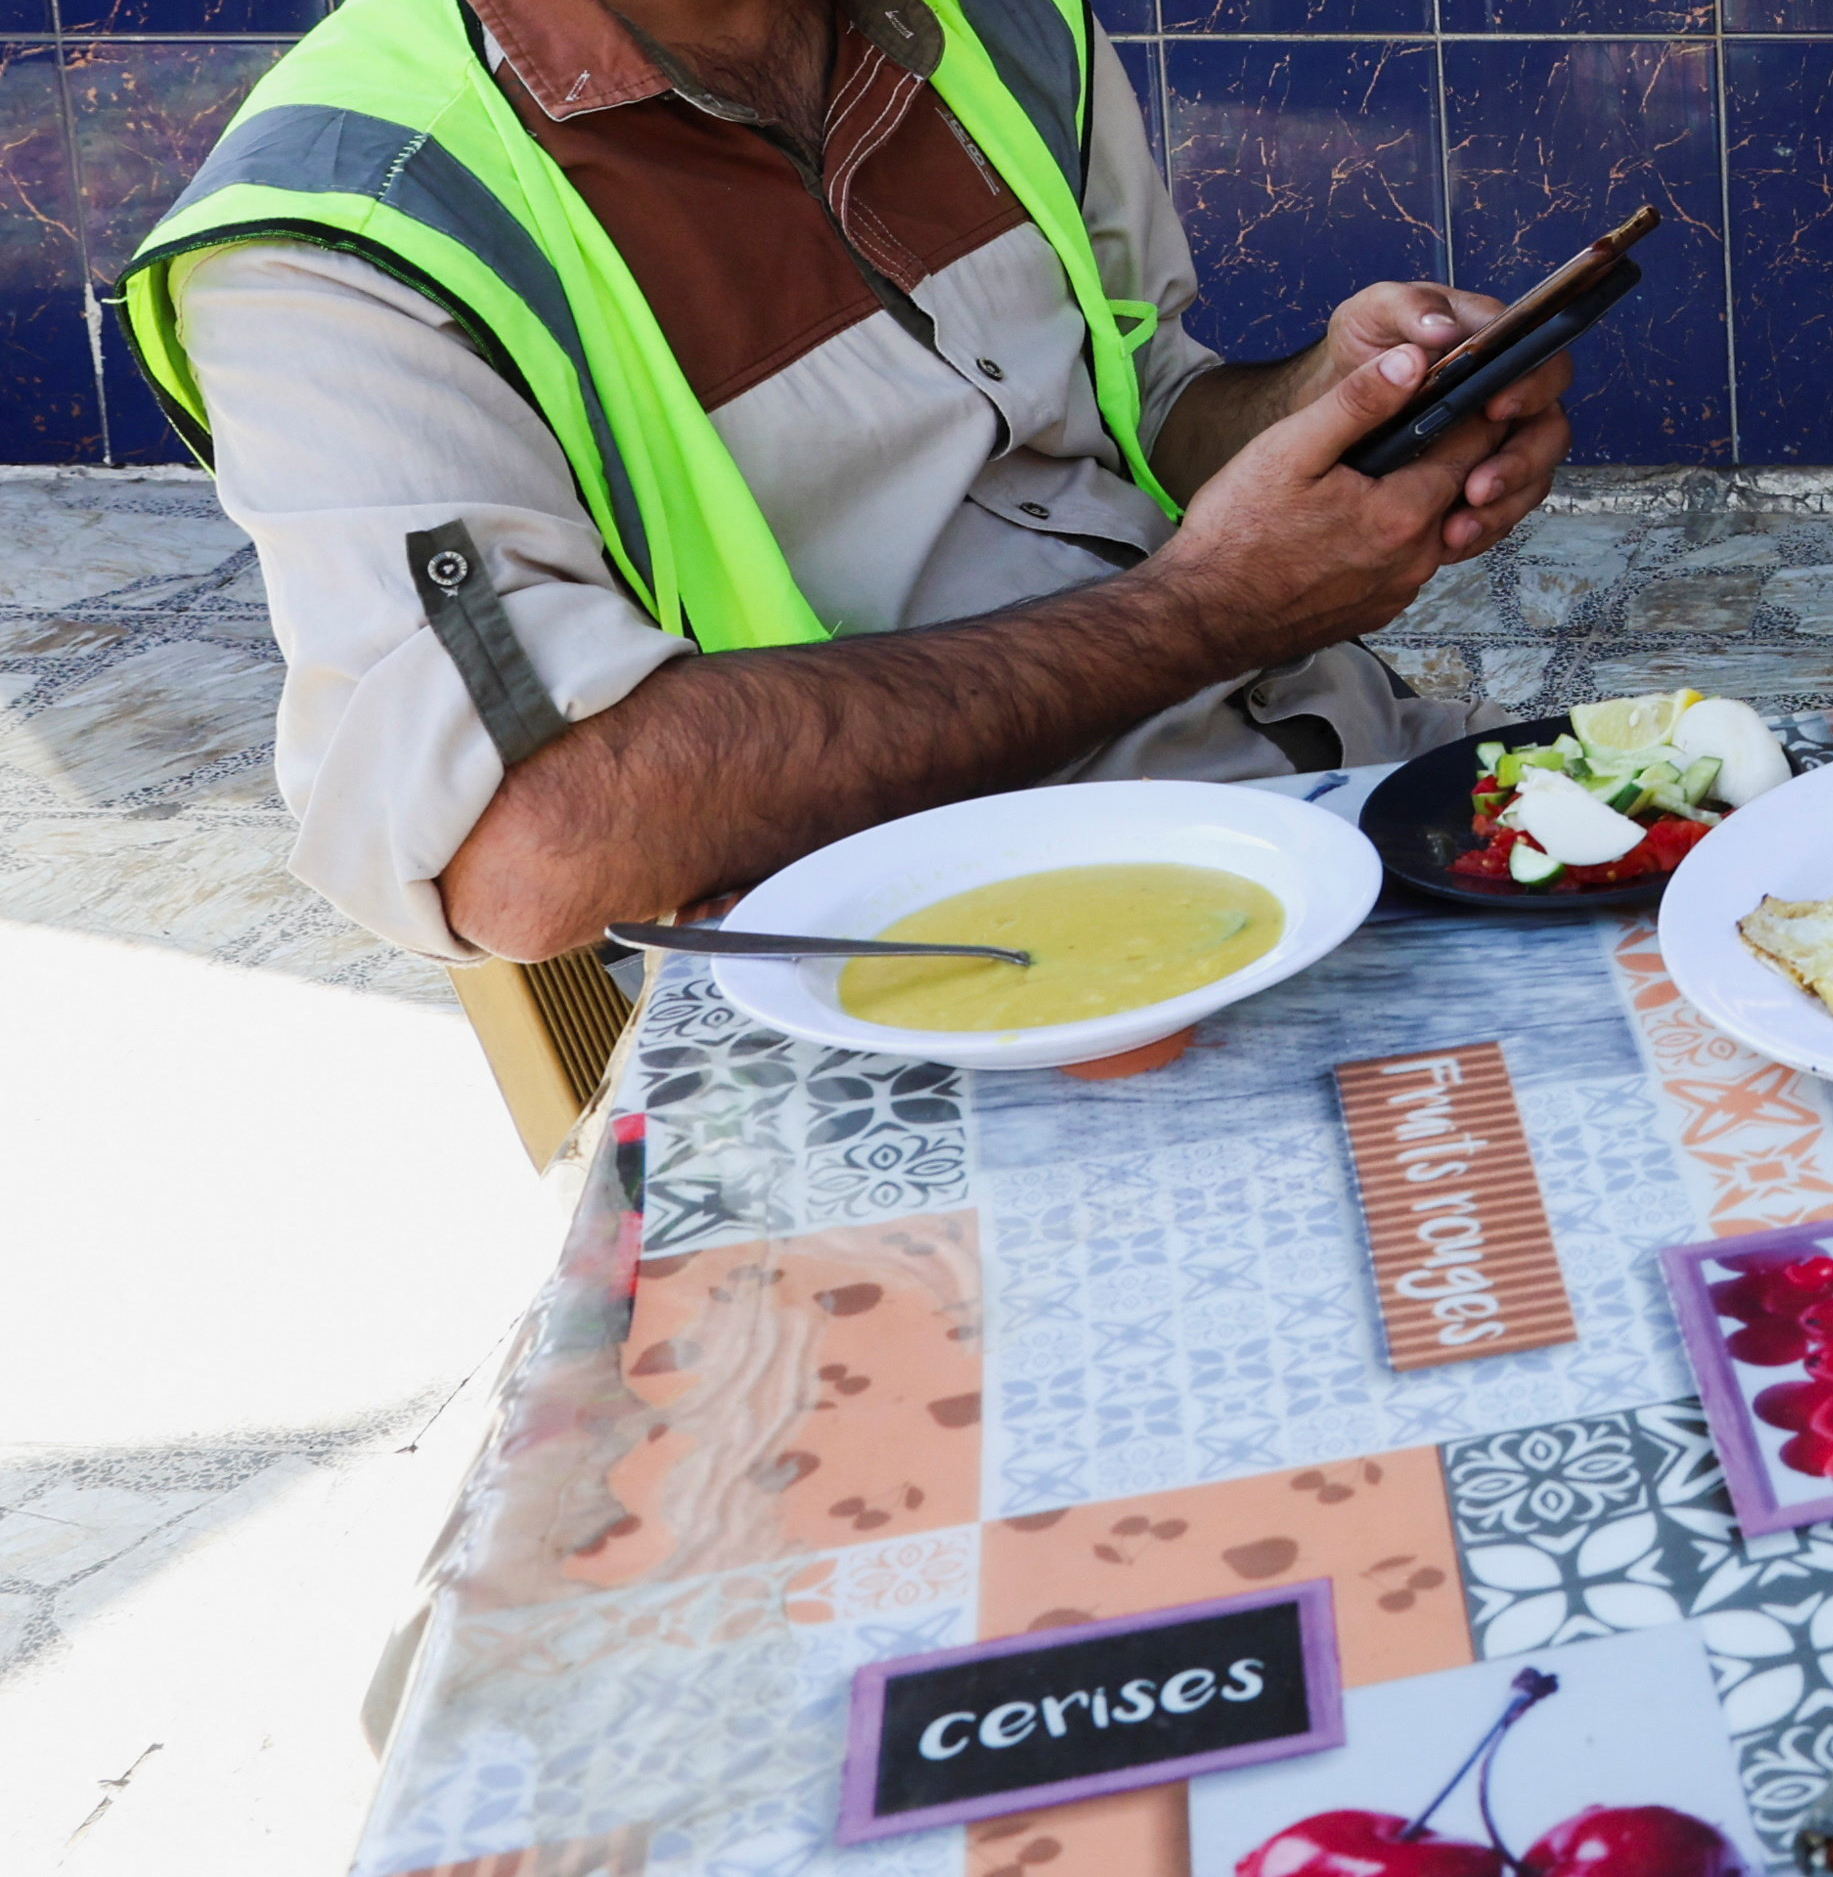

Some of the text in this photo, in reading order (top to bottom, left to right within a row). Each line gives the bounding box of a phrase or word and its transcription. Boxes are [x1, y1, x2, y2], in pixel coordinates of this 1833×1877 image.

[1381, 1056, 1507, 1347] Fruits rouges
[918, 1657, 1267, 1761] cerises
